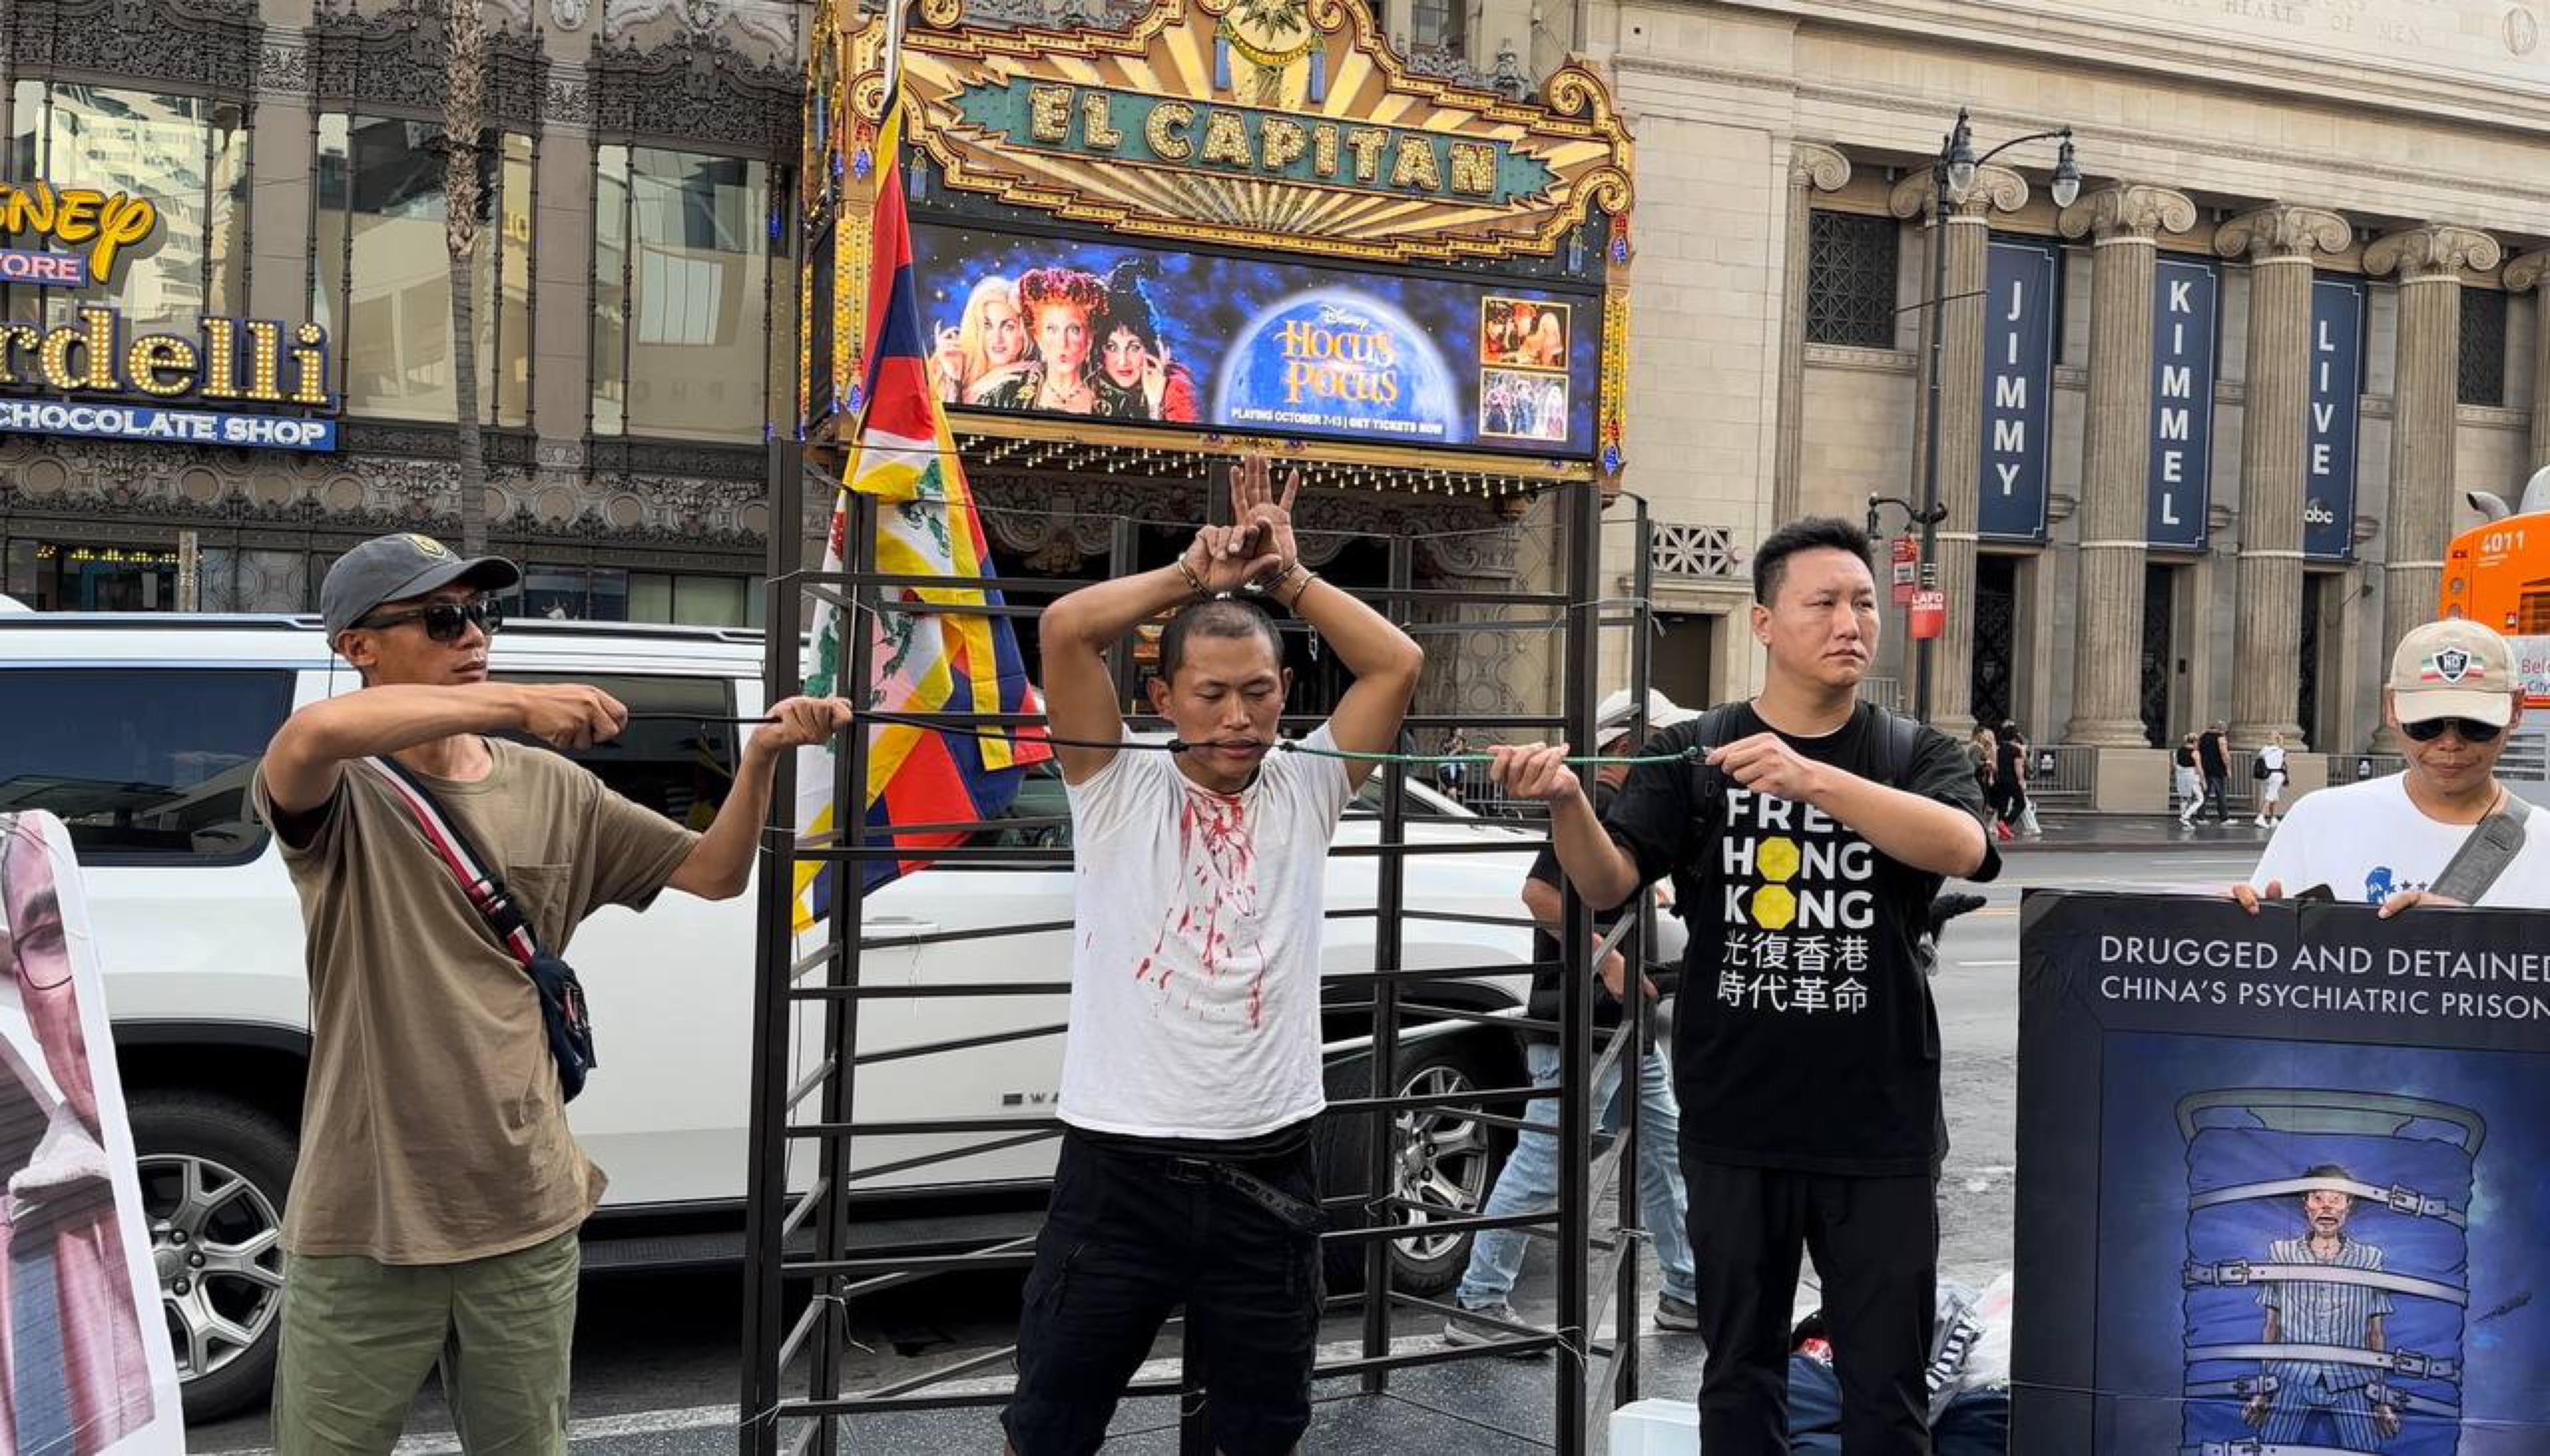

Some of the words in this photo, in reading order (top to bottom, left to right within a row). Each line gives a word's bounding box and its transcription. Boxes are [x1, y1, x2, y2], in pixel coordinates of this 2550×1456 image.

[1028, 84, 1122, 151] EL
[1145, 102, 1496, 194] CAPITAN
[0, 179, 156, 284] NEY
[0, 254, 80, 281] ORE
[0, 307, 328, 402] rdelli
[1274, 319, 1396, 367] HOCUS
[1283, 363, 1399, 405] POCUS
[1994, 281, 2027, 495] JIMMY
[2159, 280, 2191, 525] KIMMEL
[2312, 321, 2335, 475] LIVE
[224, 416, 325, 445] SHOP
[1232, 407, 1273, 421] PLAYING
[1275, 410, 1321, 425] OCTOBER
[1349, 417, 1370, 428] GET
[1373, 418, 1417, 432] TICKETS
[1419, 422, 1443, 434] NOW
[2304, 505, 2334, 525] abc
[2480, 530, 2525, 553] 4011
[1727, 788, 1856, 833] FRE
[1723, 930, 1869, 973] 光復香港
[2100, 935, 2278, 970] DRUGGED
[2291, 944, 2373, 975] AND
[1717, 971, 1869, 1014] 時代革命
[2100, 975, 2227, 1006] CHINA'S
[2238, 983, 2430, 1015] PSYCHIATRIC
[2441, 991, 2550, 1020] PRISON
